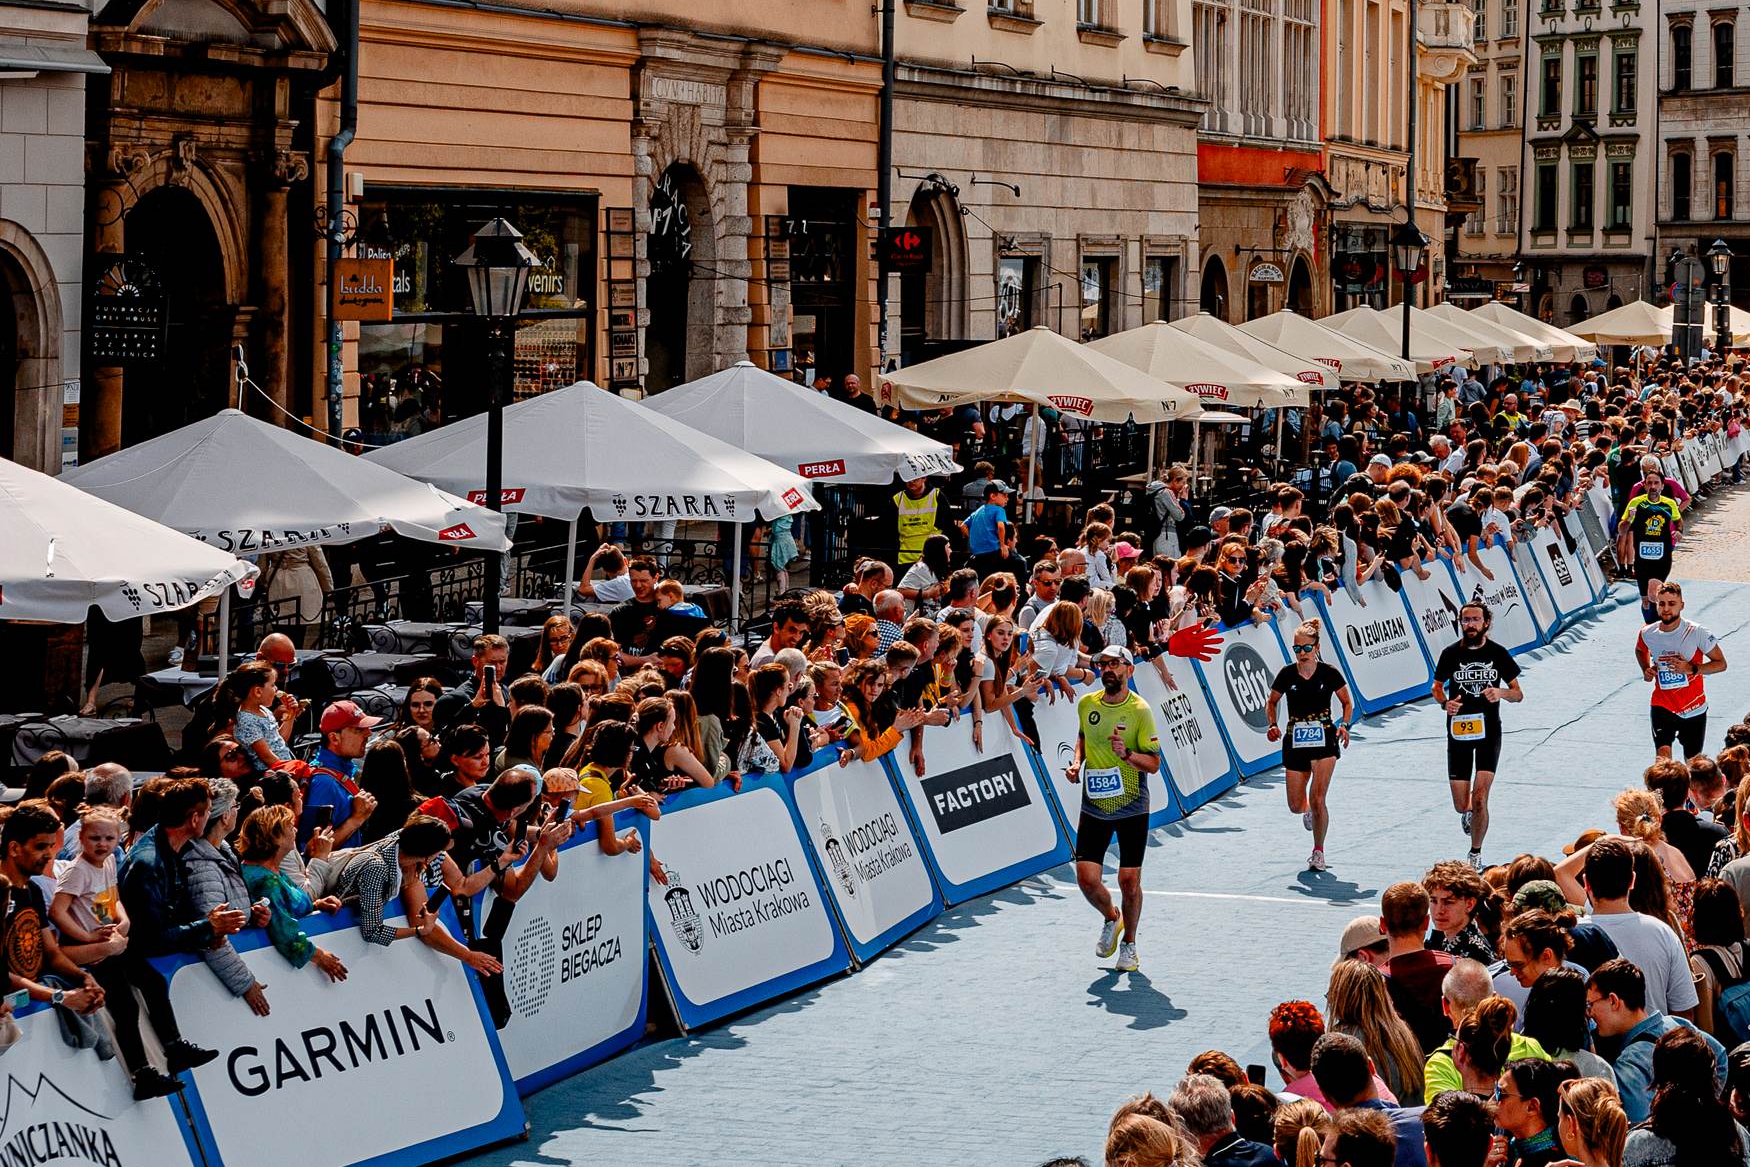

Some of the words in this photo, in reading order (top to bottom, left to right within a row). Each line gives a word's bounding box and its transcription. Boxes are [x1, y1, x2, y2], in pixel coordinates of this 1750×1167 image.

[803, 462, 841, 476] PERŁA
[473, 490, 517, 503] PŁA
[635, 494, 721, 517] SZARA
[1360, 615, 1406, 647] LEWIATAN
[1226, 658, 1271, 716] felix
[1455, 670, 1495, 680] WICHER
[1160, 697, 1182, 725] NICE
[1177, 693, 1192, 716] TO
[1460, 722, 1474, 731] 93
[1296, 728, 1321, 740] 1784
[933, 768, 1017, 816] FACTORY
[1089, 776, 1118, 789] 1584
[843, 811, 900, 856] WODOCIĄGI
[854, 852, 879, 884] Miasta
[876, 839, 913, 876] Krakowa
[697, 857, 795, 911] WODOCIĄGI
[708, 903, 753, 940] Miasta
[752, 886, 811, 927] Krakowa
[561, 913, 603, 953] SKLEP
[560, 934, 623, 985] BIEGACZA
[226, 997, 446, 1098] GARMIN
